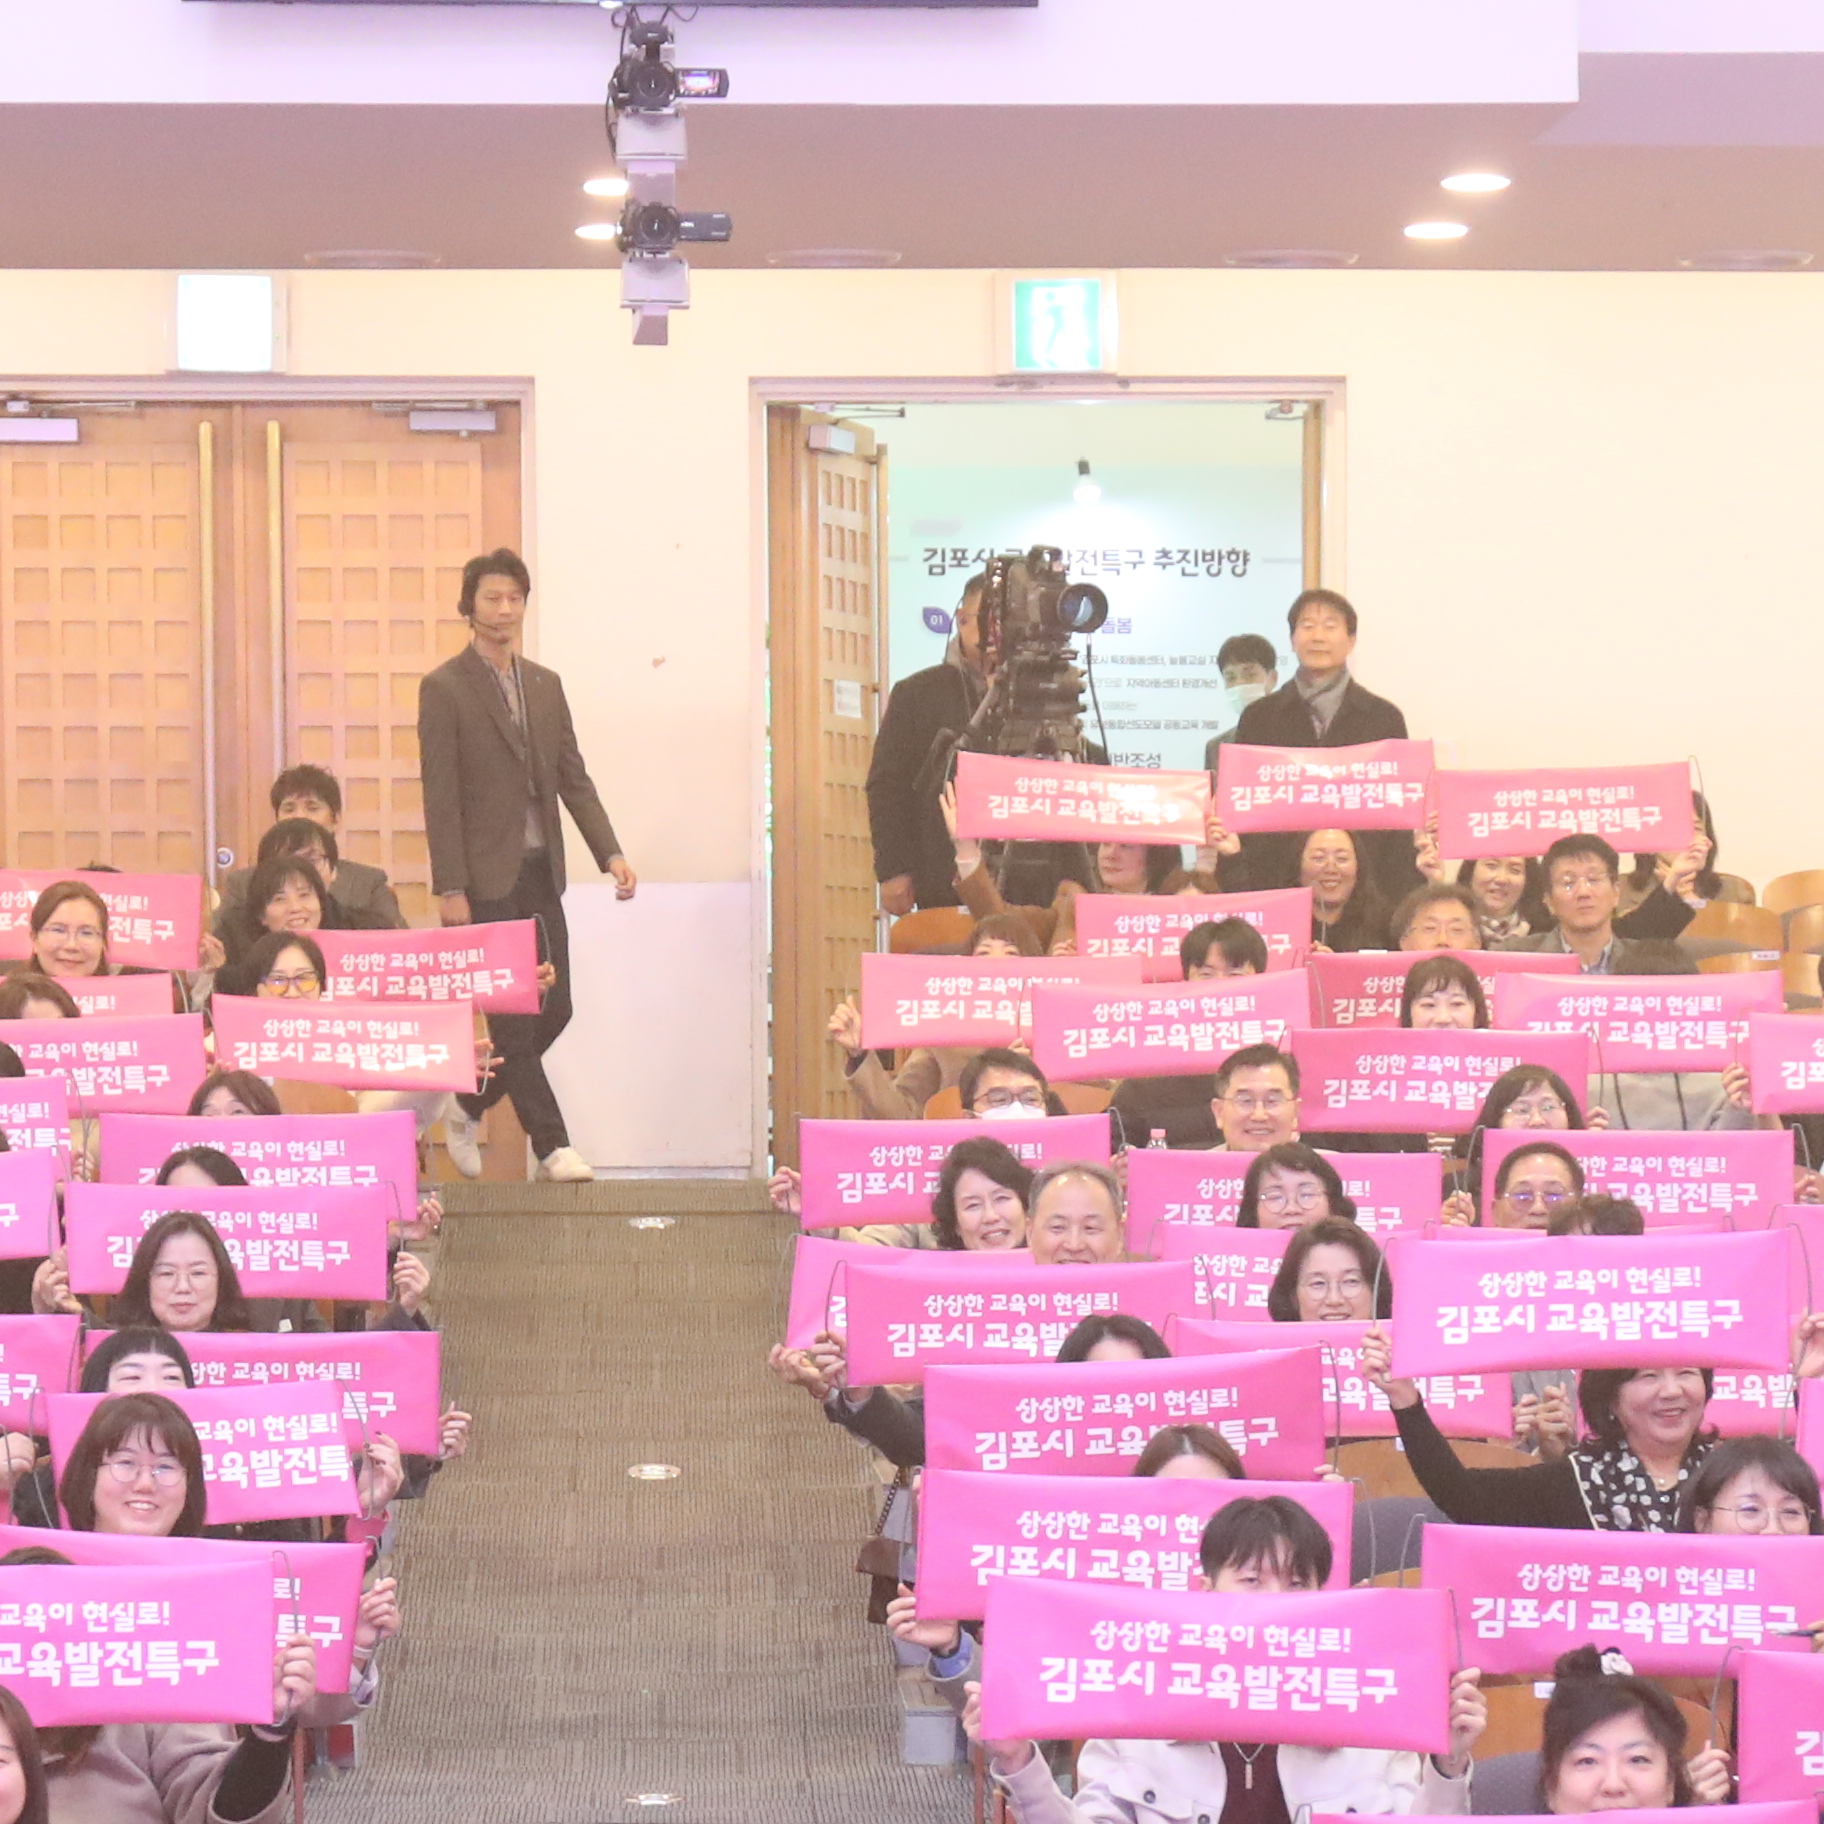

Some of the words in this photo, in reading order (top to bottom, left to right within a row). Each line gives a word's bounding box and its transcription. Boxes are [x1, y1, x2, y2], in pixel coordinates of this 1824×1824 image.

[1152, 547, 1252, 578] 추진방향
[930, 614, 943, 625] 01
[1493, 788, 1539, 809] 상상한
[1541, 787, 1583, 806] 교육이
[1585, 785, 1635, 806] 현실로!
[1467, 810, 1532, 838] 김포시
[1537, 805, 1663, 835] 교육발전특구
[1092, 1000, 1143, 1023] 상상한
[1148, 998, 1196, 1018] 교육이
[1200, 995, 1256, 1018] 현실로!
[263, 1018, 312, 1038] 상상한
[316, 1019, 362, 1038] 교육이
[366, 1019, 419, 1040] 현실로!
[1063, 1025, 1136, 1059] 김포시
[1143, 1018, 1288, 1052] 교육발전특구
[233, 1041, 304, 1070] 김포시
[1477, 1269, 1548, 1299] 상상한
[1553, 1268, 1619, 1296] 교육이
[1625, 1265, 1701, 1295] 현실로!
[1435, 1303, 1536, 1345] 김포시
[1545, 1299, 1744, 1341] 교육발전특구
[1517, 1563, 1592, 1593] 상상한
[1597, 1565, 1668, 1594] 교육이
[1674, 1565, 1756, 1597] 현실로!
[81, 1600, 171, 1633] 현실로!
[1471, 1597, 1577, 1639] 김포시
[1586, 1600, 1799, 1646] 교육발전특구
[1090, 1620, 1171, 1653] 상상한
[1177, 1623, 1255, 1655] 교육이
[1263, 1625, 1351, 1658] 현실로!
[1039, 1656, 1155, 1703] 김포시
[1167, 1662, 1398, 1713] 교육발전특구
